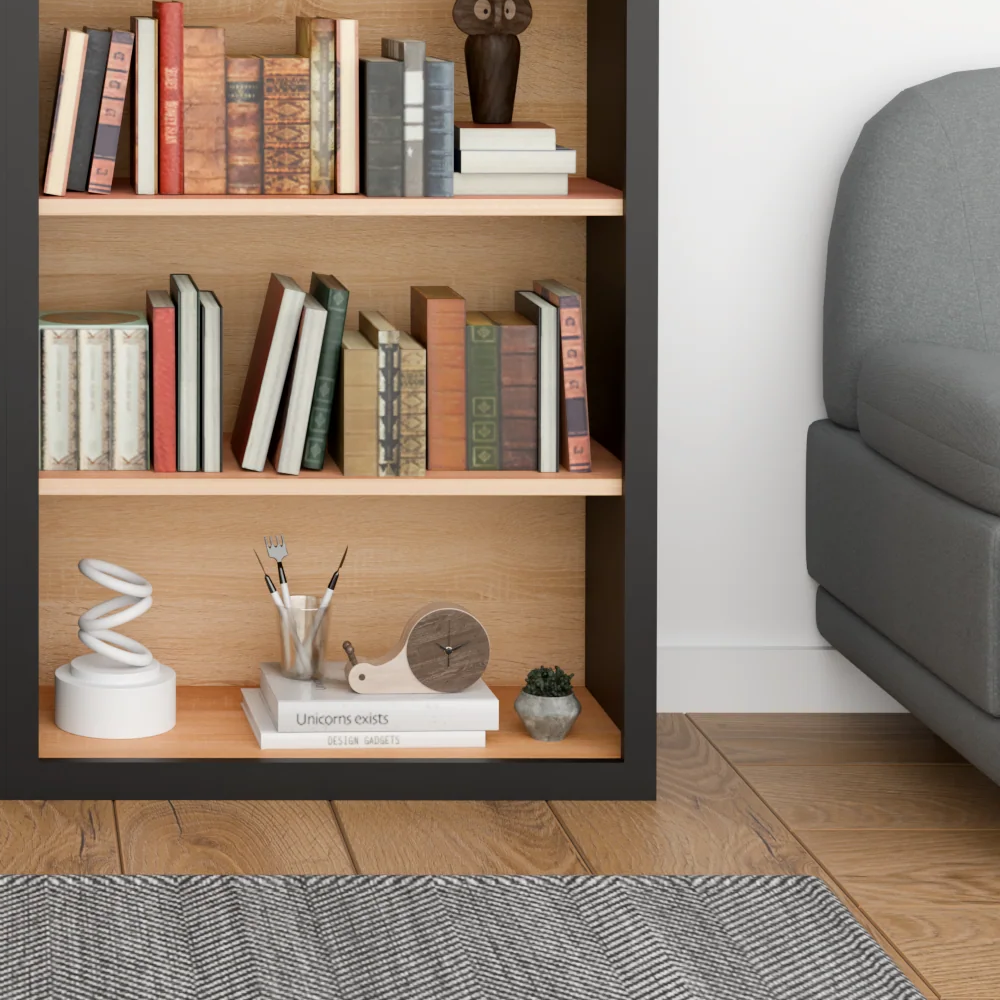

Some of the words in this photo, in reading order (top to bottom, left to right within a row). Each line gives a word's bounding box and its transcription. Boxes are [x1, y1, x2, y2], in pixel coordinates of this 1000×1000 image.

[296, 713, 352, 726] Unicorns
[354, 713, 389, 726] exists
[327, 735, 360, 746] DESIGN
[363, 735, 401, 746] GADGETS
